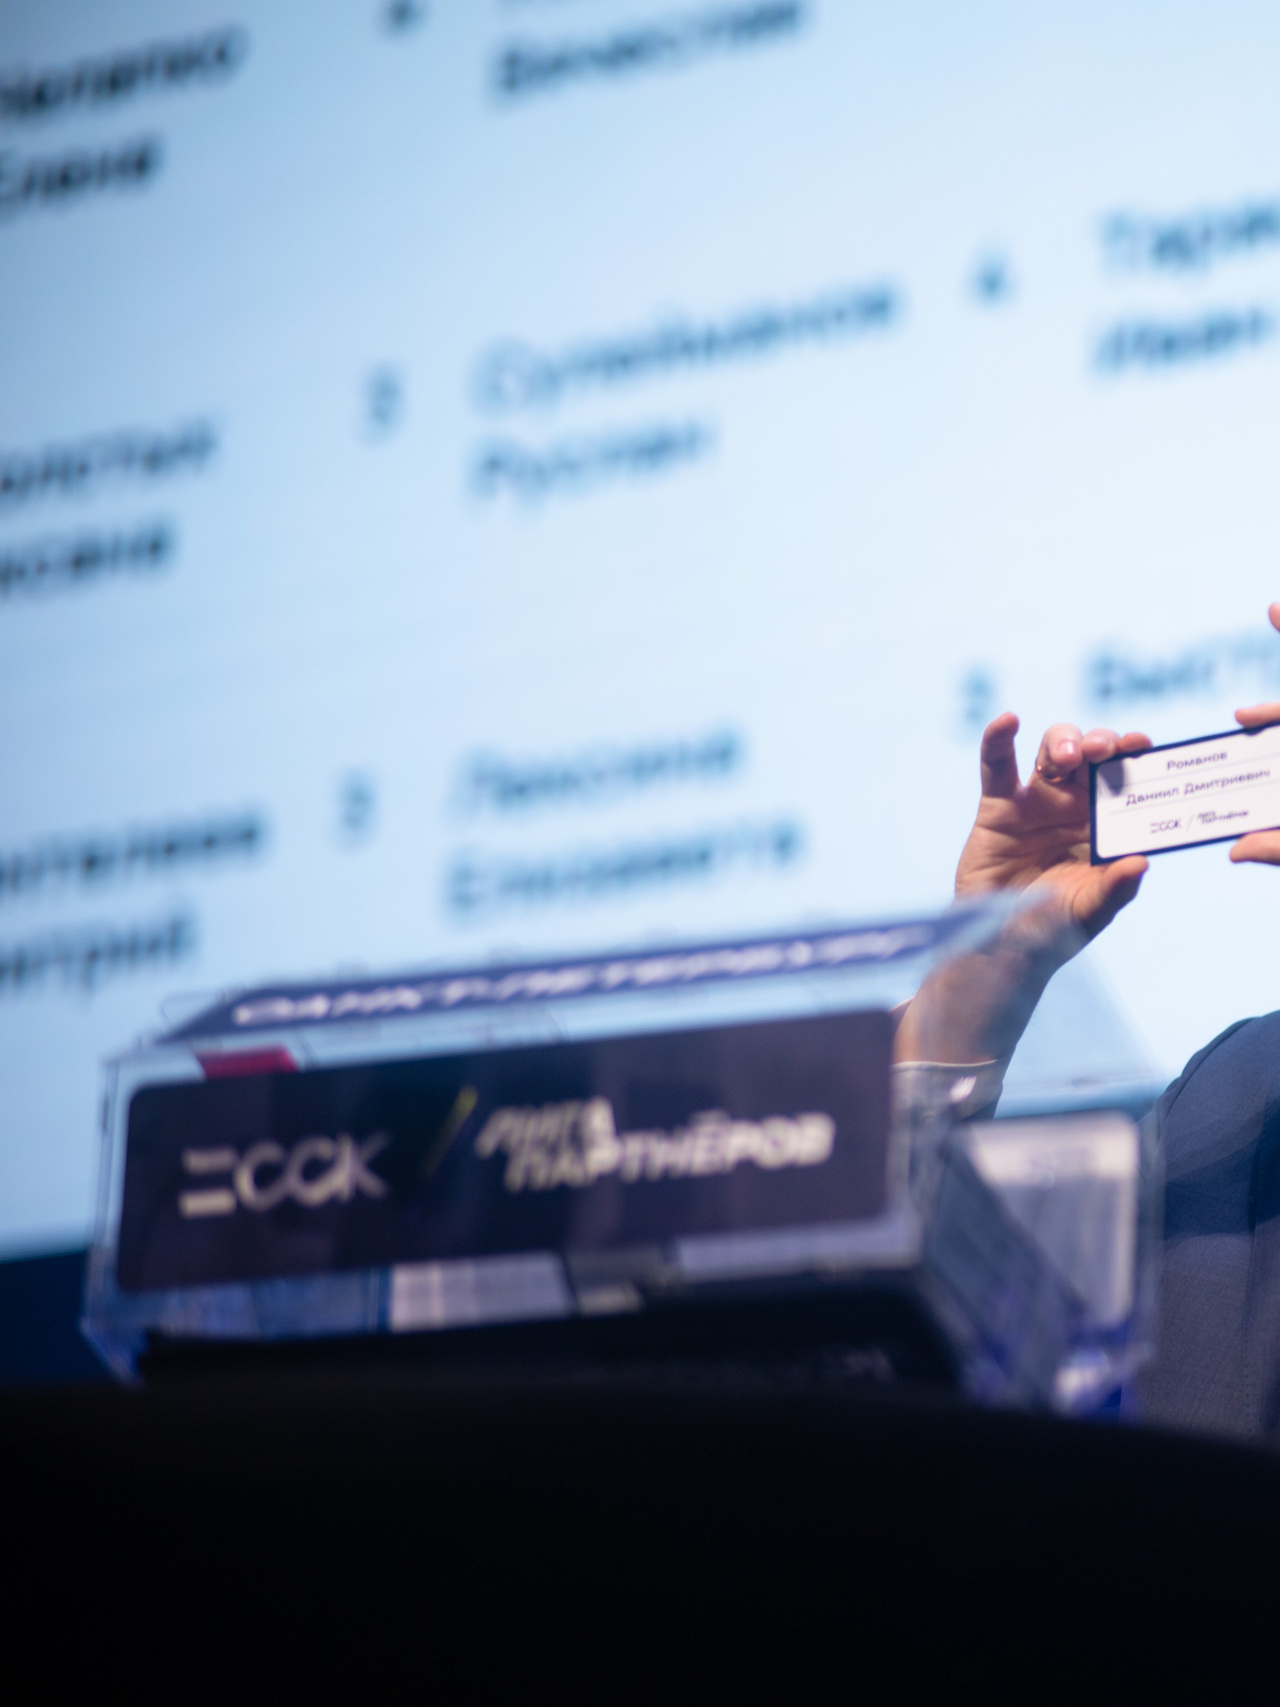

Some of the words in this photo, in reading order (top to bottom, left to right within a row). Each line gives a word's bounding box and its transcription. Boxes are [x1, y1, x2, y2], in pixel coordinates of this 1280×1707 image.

[1166, 751, 1228, 771] Романов
[1126, 786, 1179, 806] Даниил
[1184, 768, 1271, 795] Дмитриевич
[504, 1108, 837, 1194] ПАРТНЁРОВ
